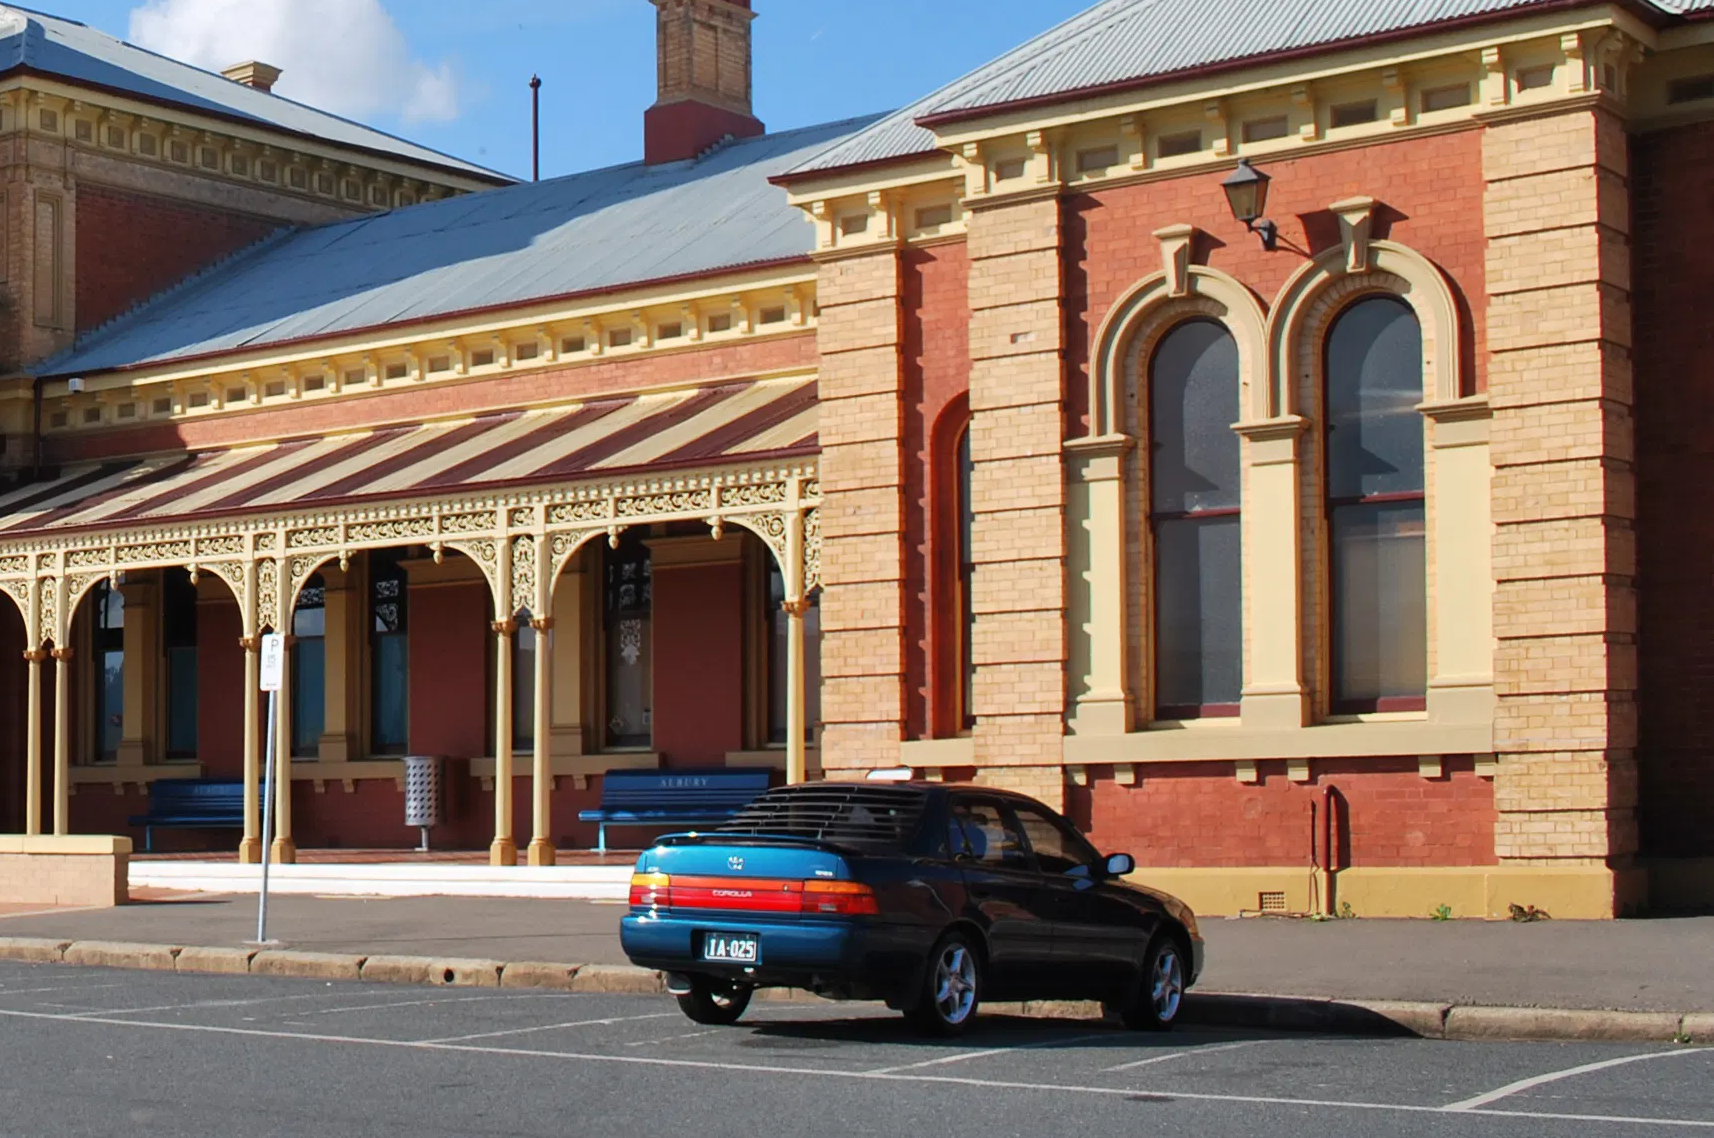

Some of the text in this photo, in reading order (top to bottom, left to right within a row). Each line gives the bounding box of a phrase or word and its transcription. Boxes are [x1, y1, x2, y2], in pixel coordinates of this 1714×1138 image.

[271, 637, 278, 652] P
[660, 777, 709, 787] ALBURY
[712, 889, 752, 898] COROLLA
